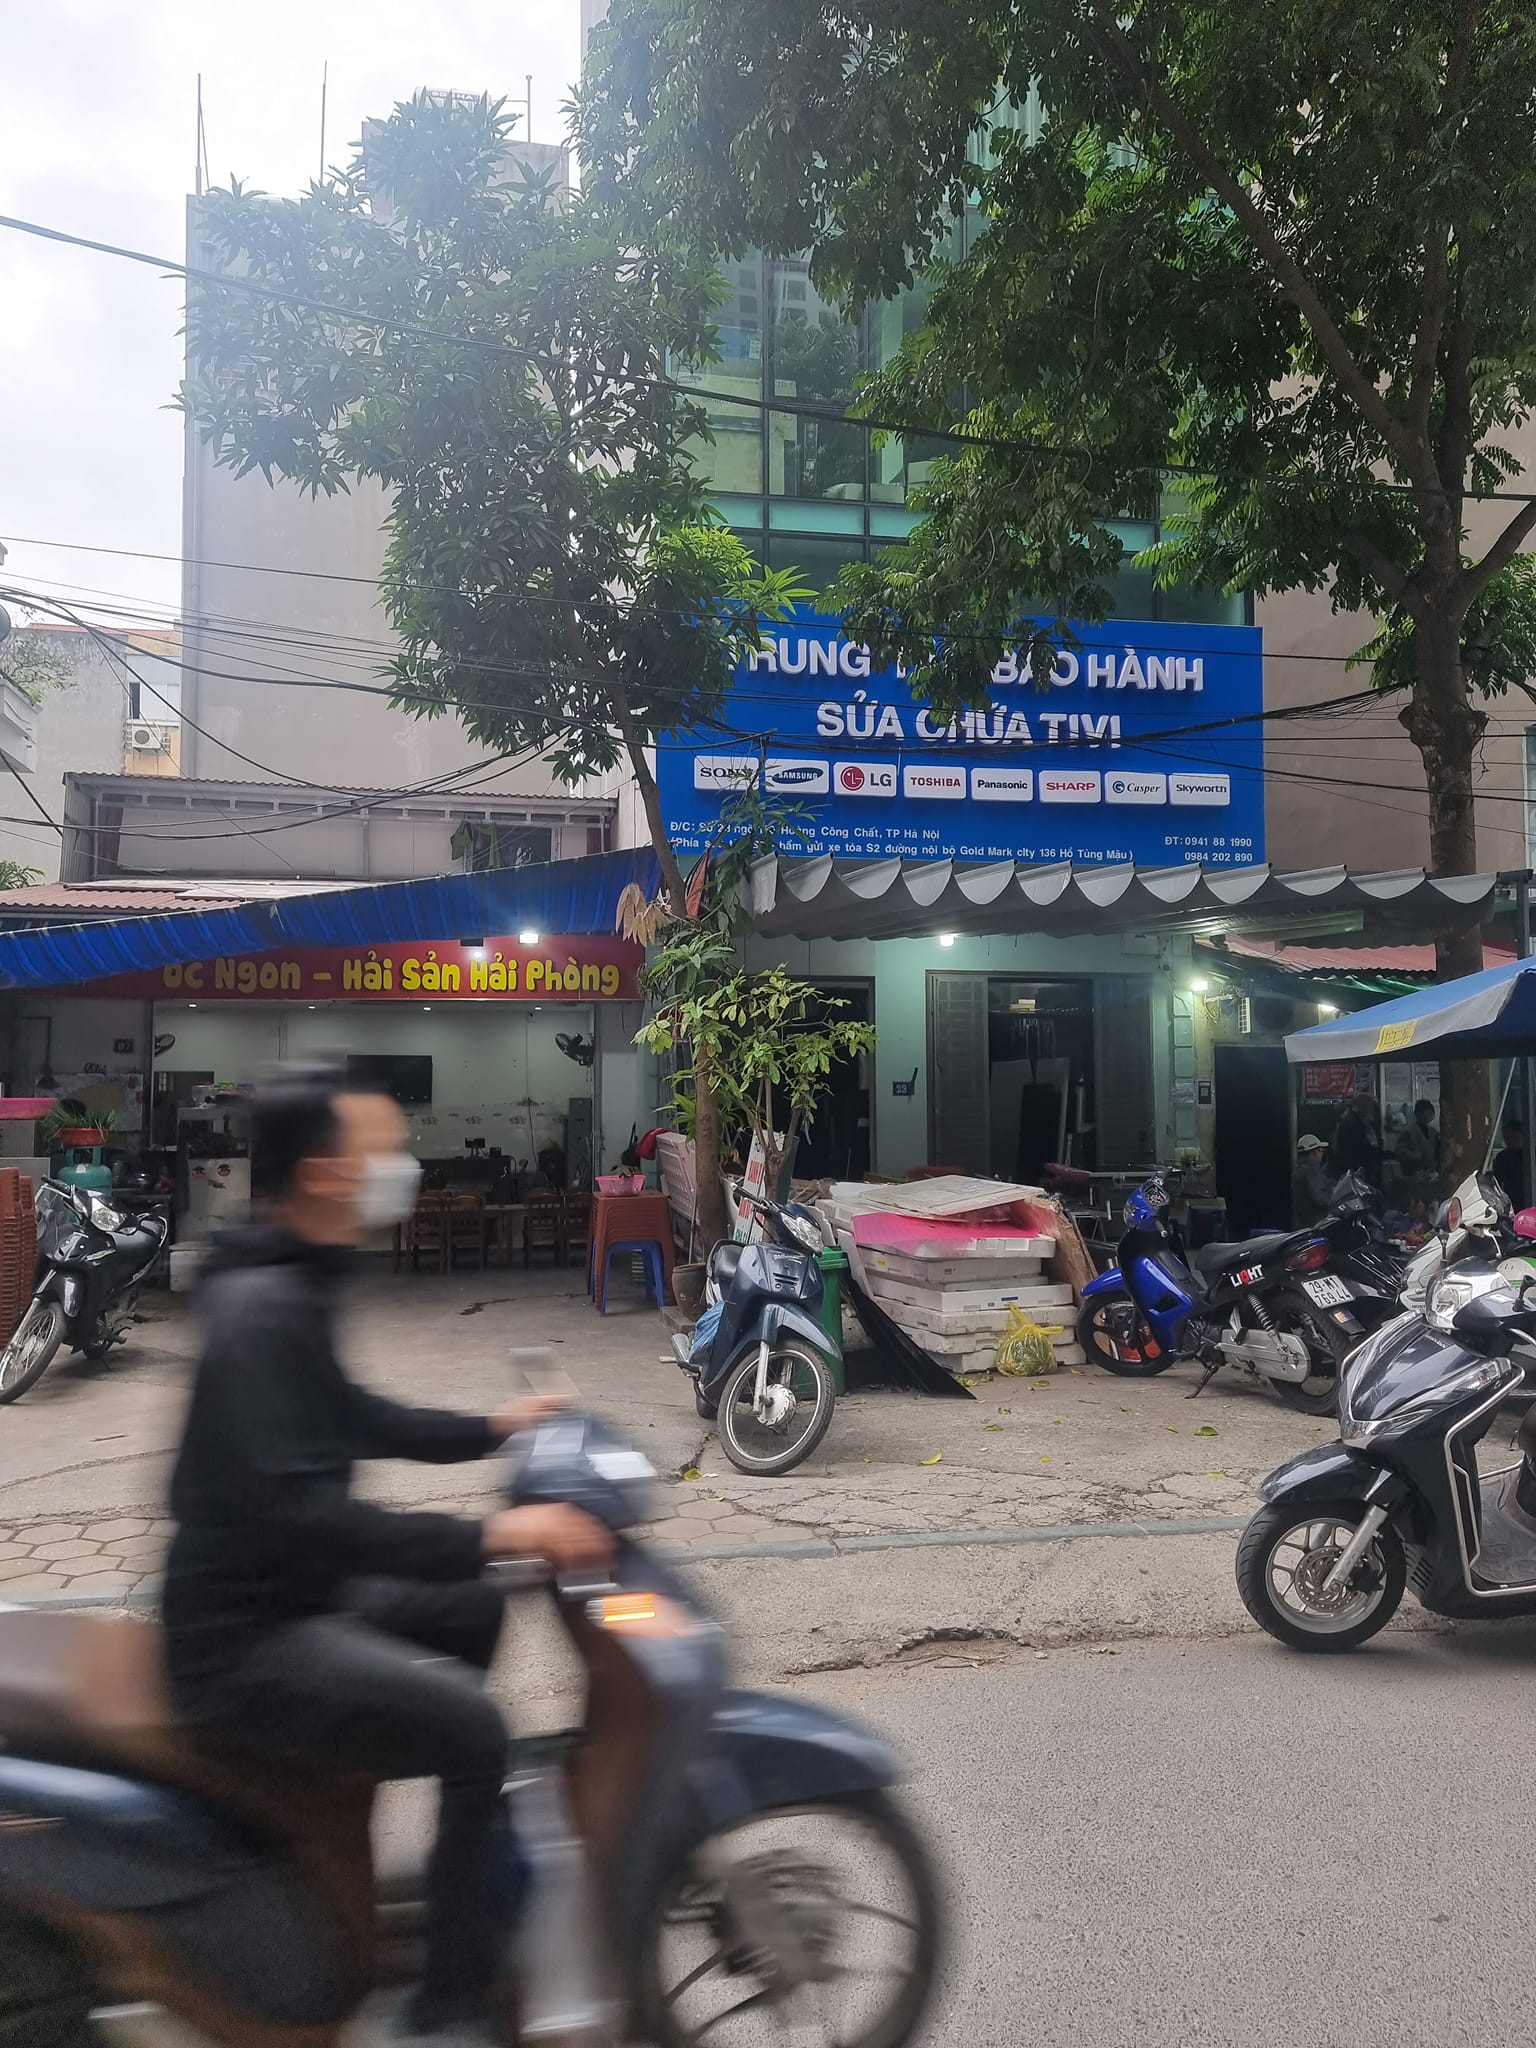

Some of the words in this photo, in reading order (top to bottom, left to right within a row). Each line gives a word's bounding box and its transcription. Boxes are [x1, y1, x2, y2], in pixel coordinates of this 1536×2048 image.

[1088, 645, 1204, 692] HÀNH
[816, 689, 905, 741] SỬA
[1040, 712, 1121, 749] TIVI
[778, 771, 818, 781] SAMSUNG
[870, 773, 892, 787] LG
[910, 776, 961, 787] TOSHIBA
[978, 779, 1028, 790] Panasonic
[1046, 782, 1096, 791] SHARP
[1127, 782, 1161, 793] Casper
[1176, 784, 1227, 794] Skyworth
[821, 827, 849, 839] Công
[886, 828, 900, 838] TP
[904, 829, 918, 839] Hà
[923, 830, 940, 842] Nội
[1213, 837, 1226, 846] 88
[1230, 838, 1252, 847] 1990
[828, 843, 841, 852] xe
[845, 842, 862, 853] tòa
[866, 843, 880, 853] S2
[885, 843, 918, 856] đường
[922, 844, 938, 857] nội
[942, 845, 956, 857] bộ
[960, 845, 984, 856] Gold
[988, 846, 1013, 857] Mark
[1040, 848, 1056, 858] 136
[1077, 848, 1103, 861] Tùng
[1184, 851, 1208, 861] 0984
[1212, 852, 1231, 862] 202
[1234, 852, 1253, 862] 890
[215, 957, 301, 993] Ngon
[343, 950, 393, 991] Hải
[401, 950, 461, 991] Sản
[470, 952, 518, 991] Hải
[526, 956, 620, 995] Phòng
[1314, 1289, 1351, 1306] 769.44
